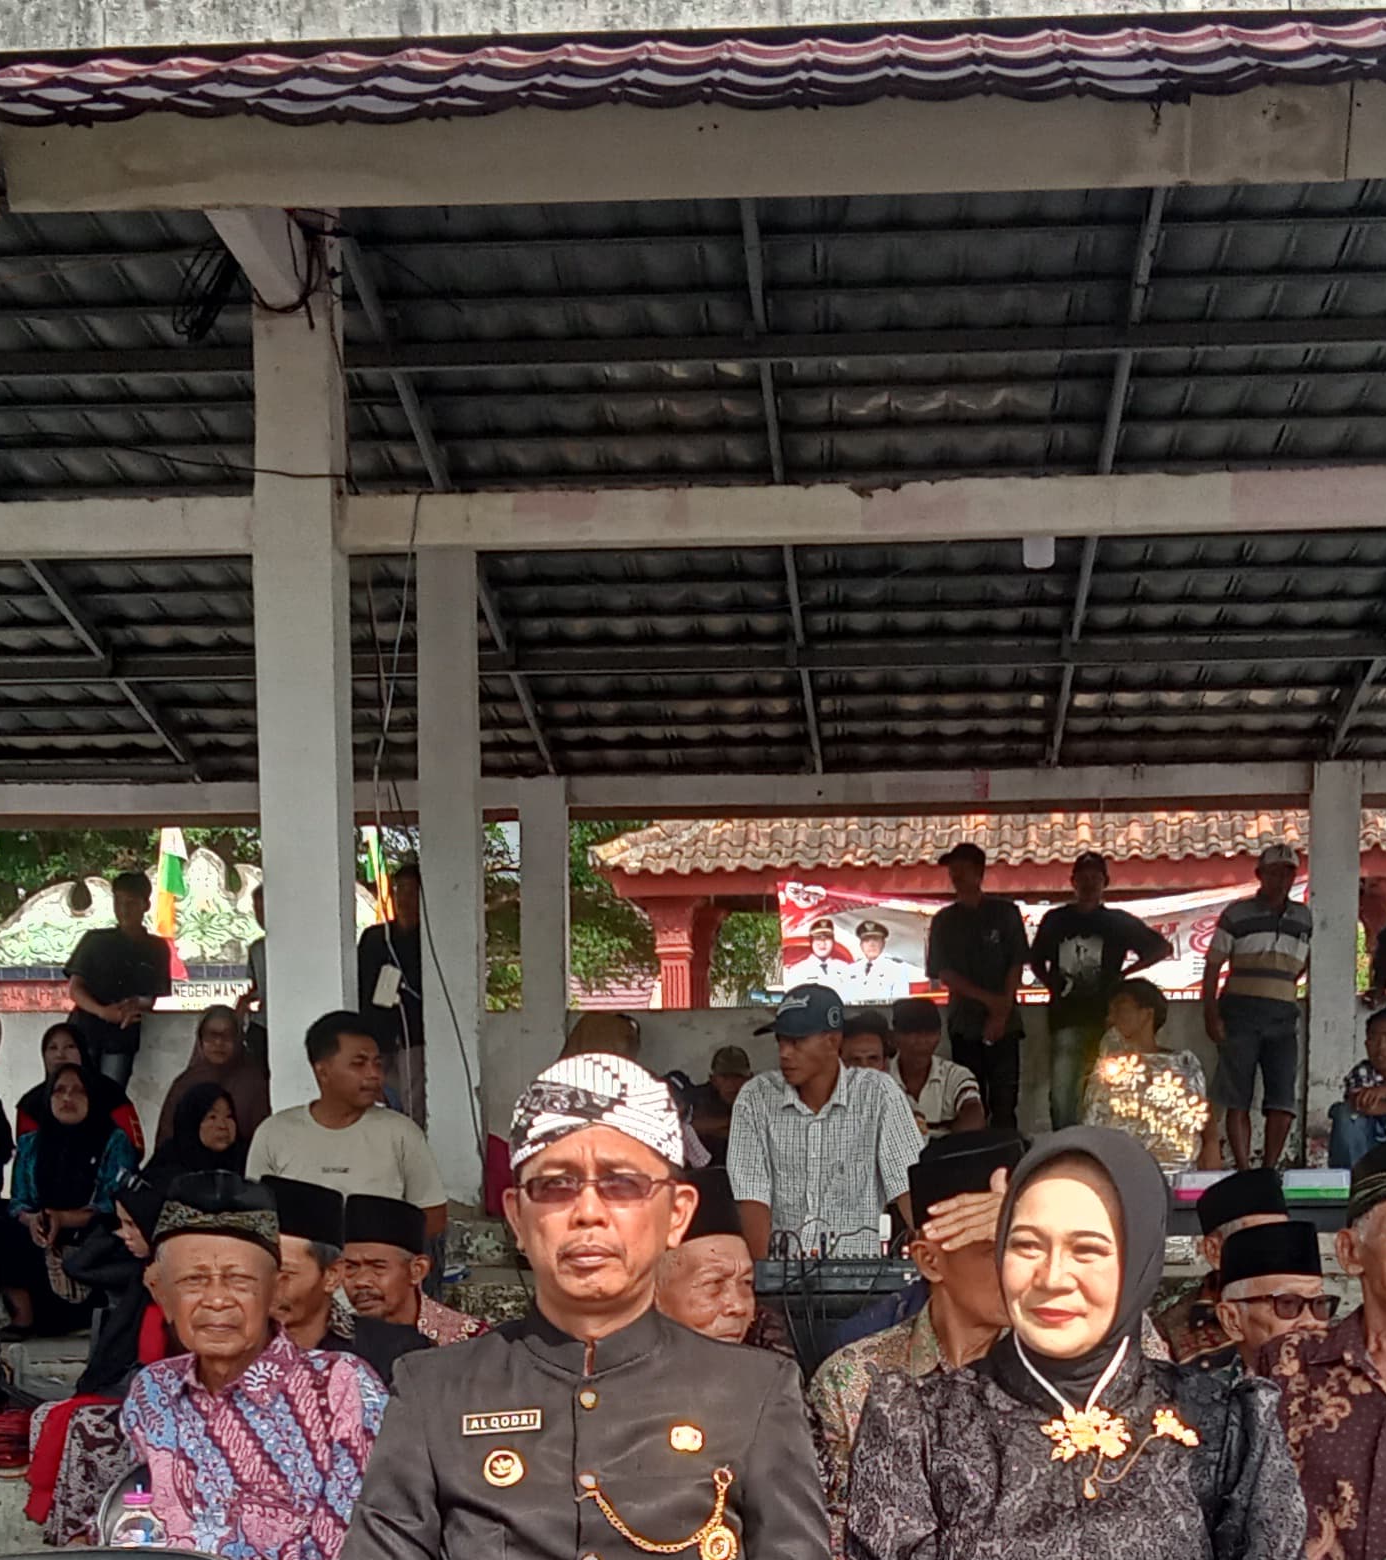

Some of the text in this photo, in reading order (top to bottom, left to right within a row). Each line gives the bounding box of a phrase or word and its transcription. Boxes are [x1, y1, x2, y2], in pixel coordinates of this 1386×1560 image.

[173, 984, 211, 998] NEGERI
[470, 1414, 535, 1430] AL QODRI
